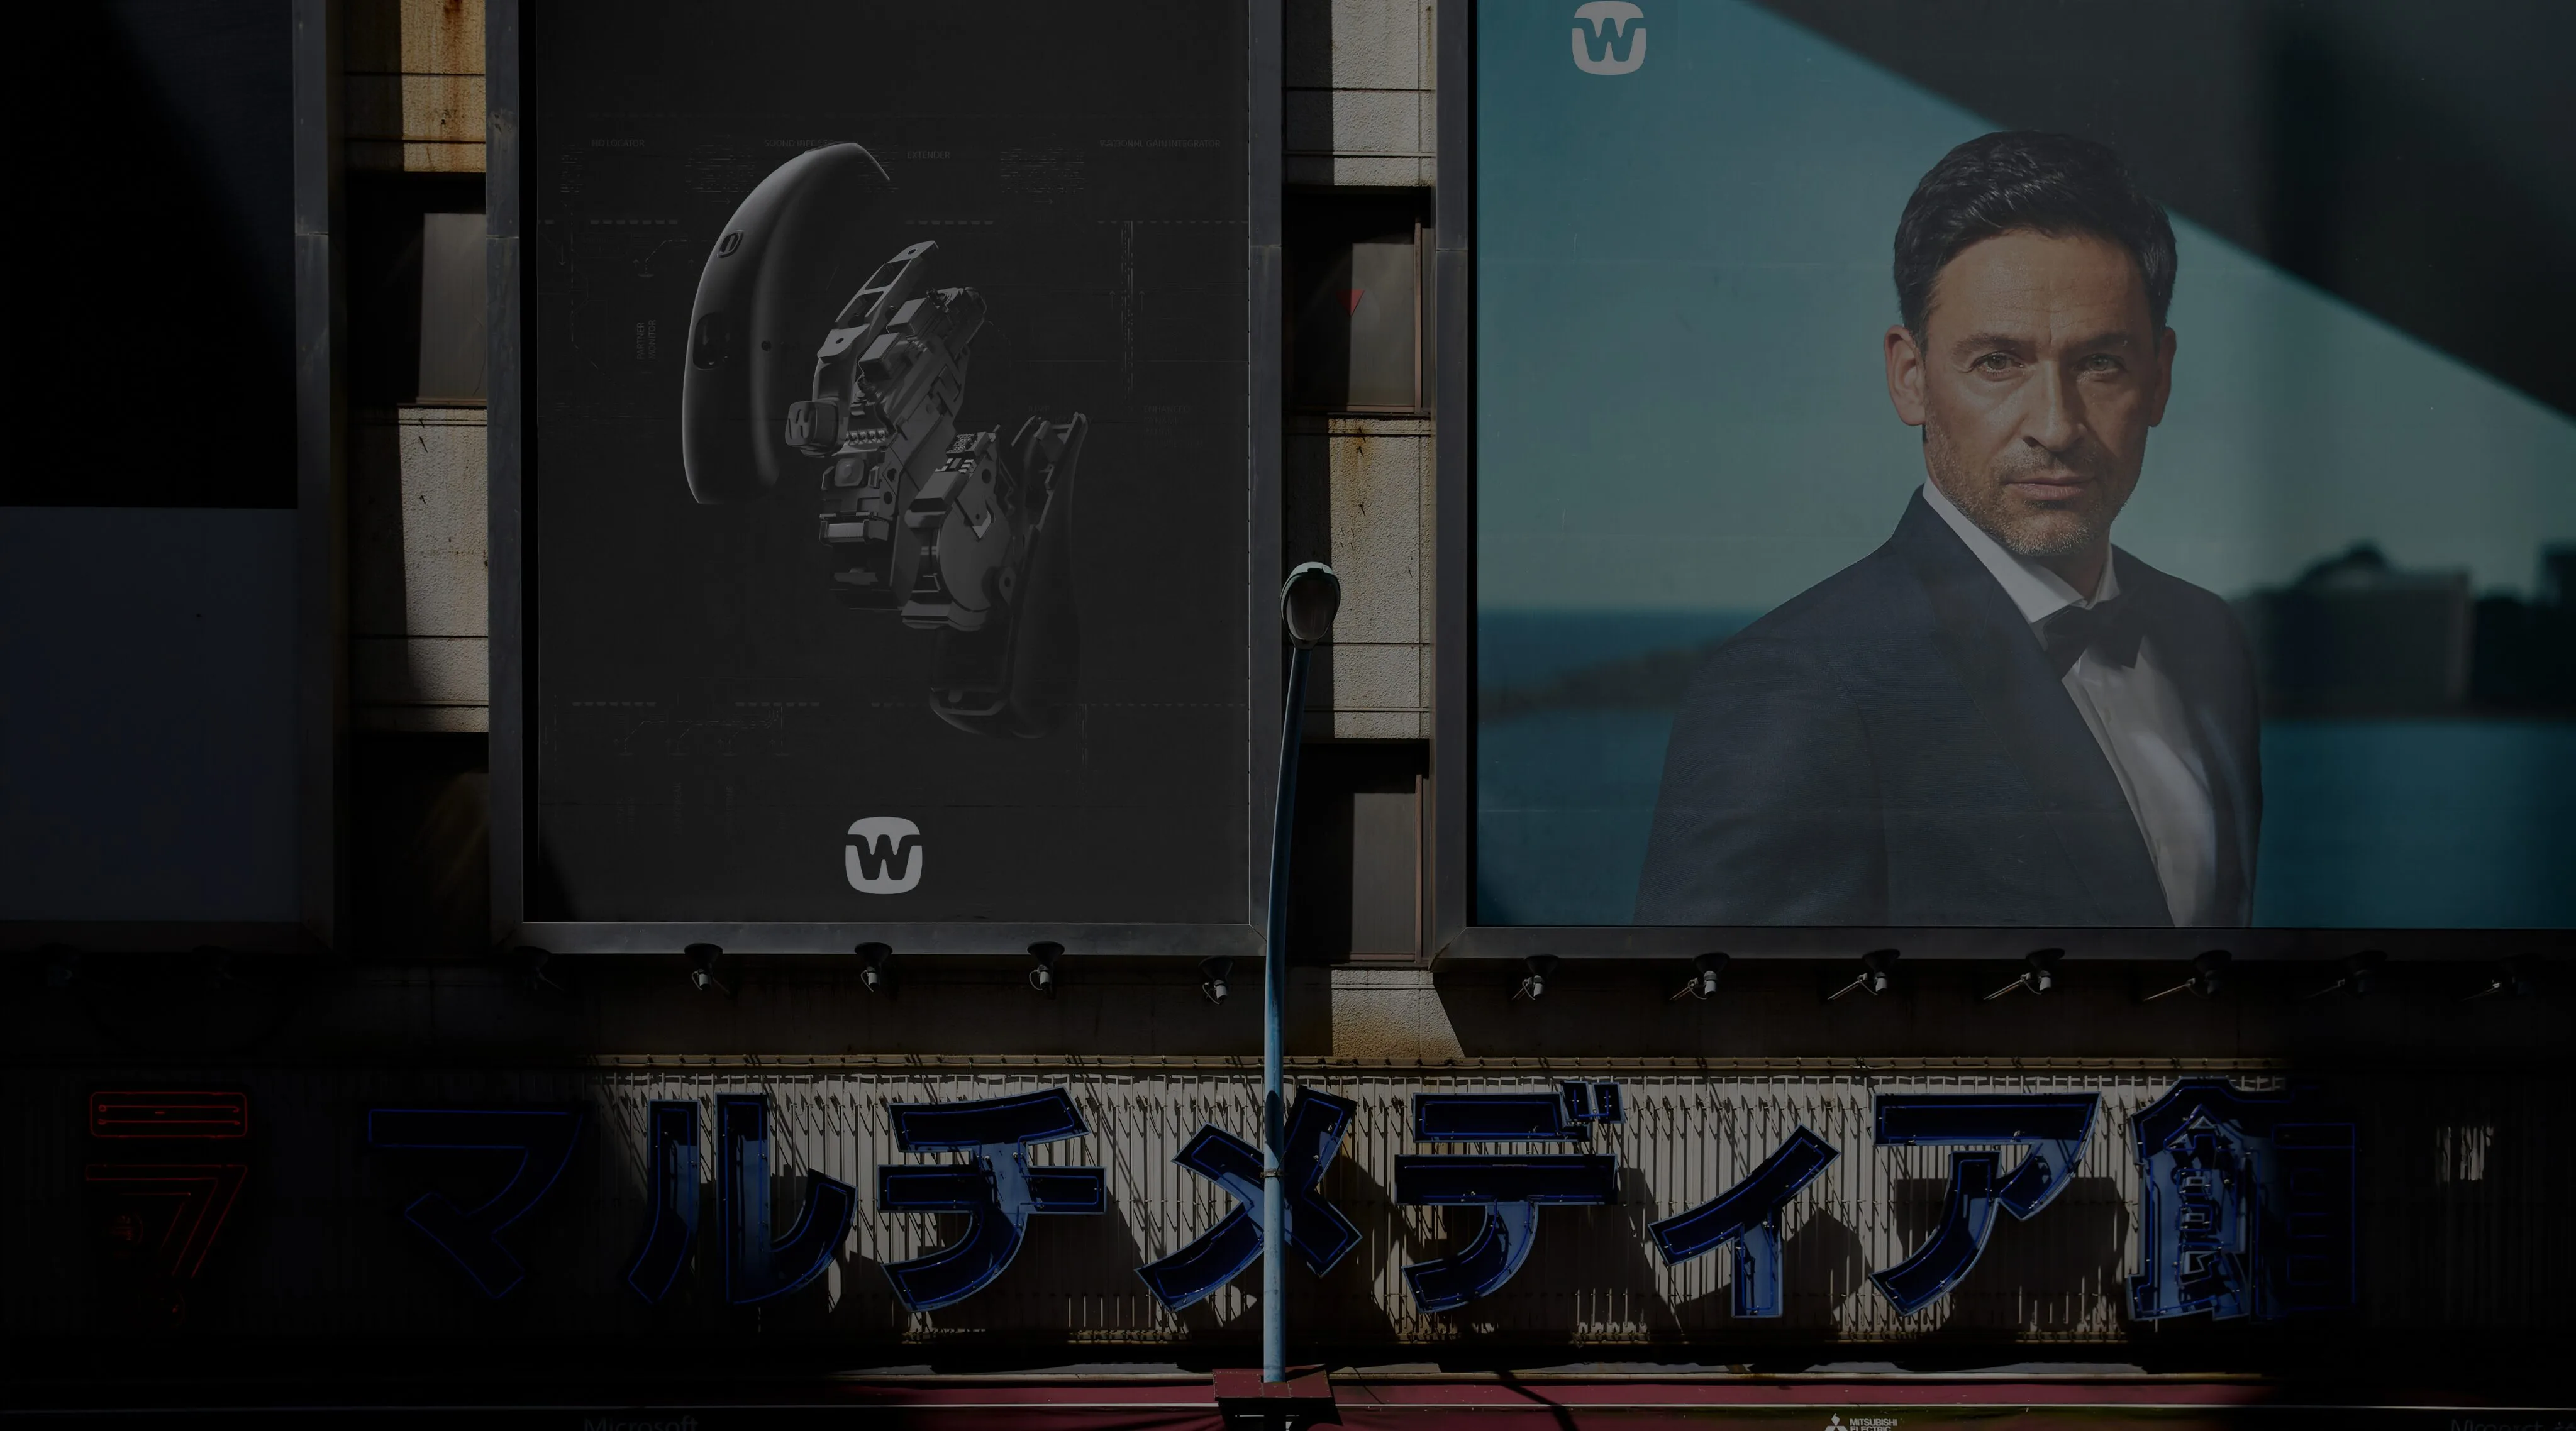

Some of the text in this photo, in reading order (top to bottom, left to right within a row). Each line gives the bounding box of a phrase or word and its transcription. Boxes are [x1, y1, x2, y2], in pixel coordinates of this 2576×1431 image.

[592, 138, 645, 147] HD LOCATOR
[1146, 139, 1167, 148] GAIN
[1169, 139, 1221, 148] INTEGRATOR
[906, 150, 951, 160] EXTENDER
[636, 322, 646, 360] PARTNER
[648, 319, 657, 360] MONITOR
[362, 1077, 2360, 1323] マルチメディア館
[1850, 1418, 1898, 1427] MITSUBISHI
